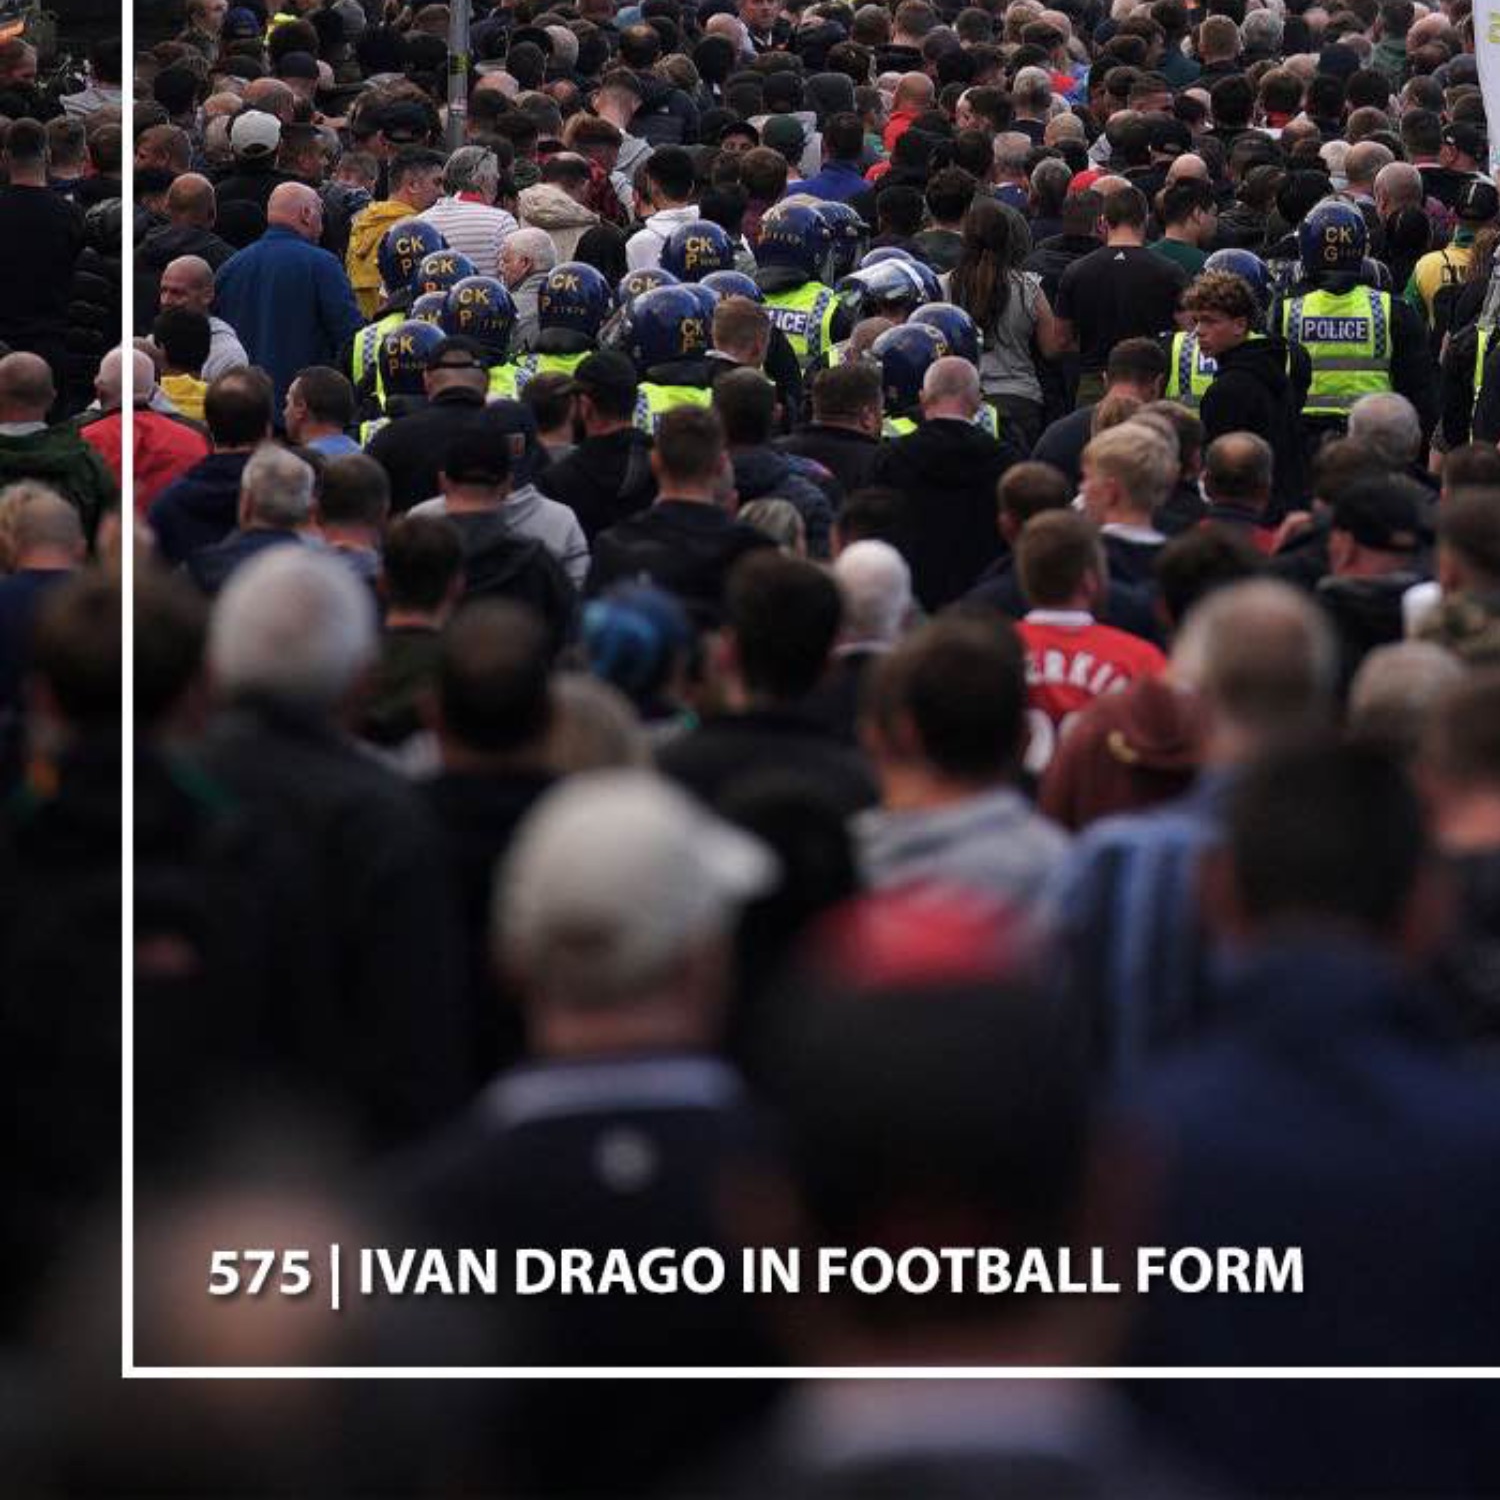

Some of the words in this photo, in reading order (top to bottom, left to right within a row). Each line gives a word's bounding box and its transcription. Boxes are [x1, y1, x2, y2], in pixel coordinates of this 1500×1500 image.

[1325, 227, 1352, 243] CK
[396, 236, 425, 254] CK
[685, 237, 713, 253] CK
[685, 255, 699, 270] P
[1324, 246, 1338, 262] G
[401, 258, 412, 276] P
[424, 255, 456, 275] CK
[550, 273, 580, 292] CK
[628, 277, 661, 293] CK
[459, 288, 490, 305] CK
[459, 310, 472, 327] P
[681, 318, 704, 337] CK
[1304, 319, 1367, 339] POLICE
[386, 335, 414, 356] CK
